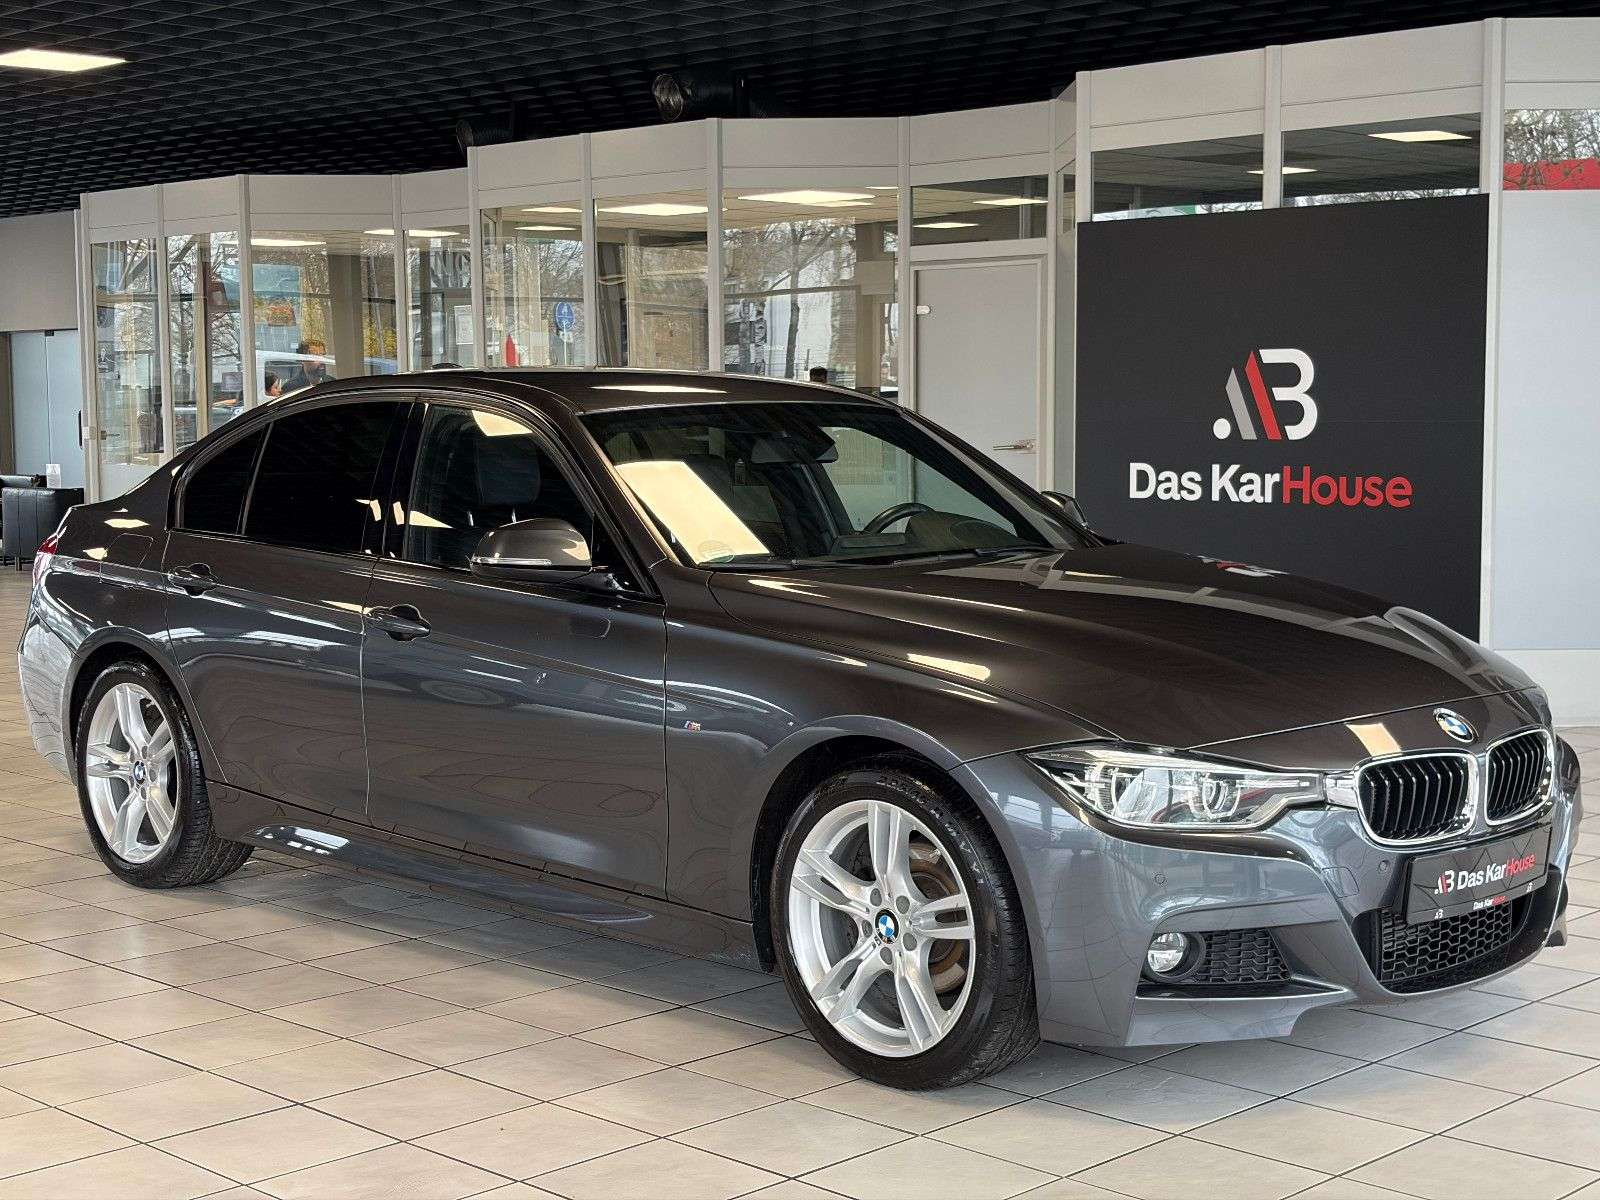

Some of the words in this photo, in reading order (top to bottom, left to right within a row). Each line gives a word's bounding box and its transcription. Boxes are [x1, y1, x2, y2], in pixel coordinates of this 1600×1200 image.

[1129, 462, 1202, 501] Das
[1211, 463, 1413, 508] KarHouse
[1457, 870, 1484, 890] Das
[1485, 854, 1536, 883] KarHouse
